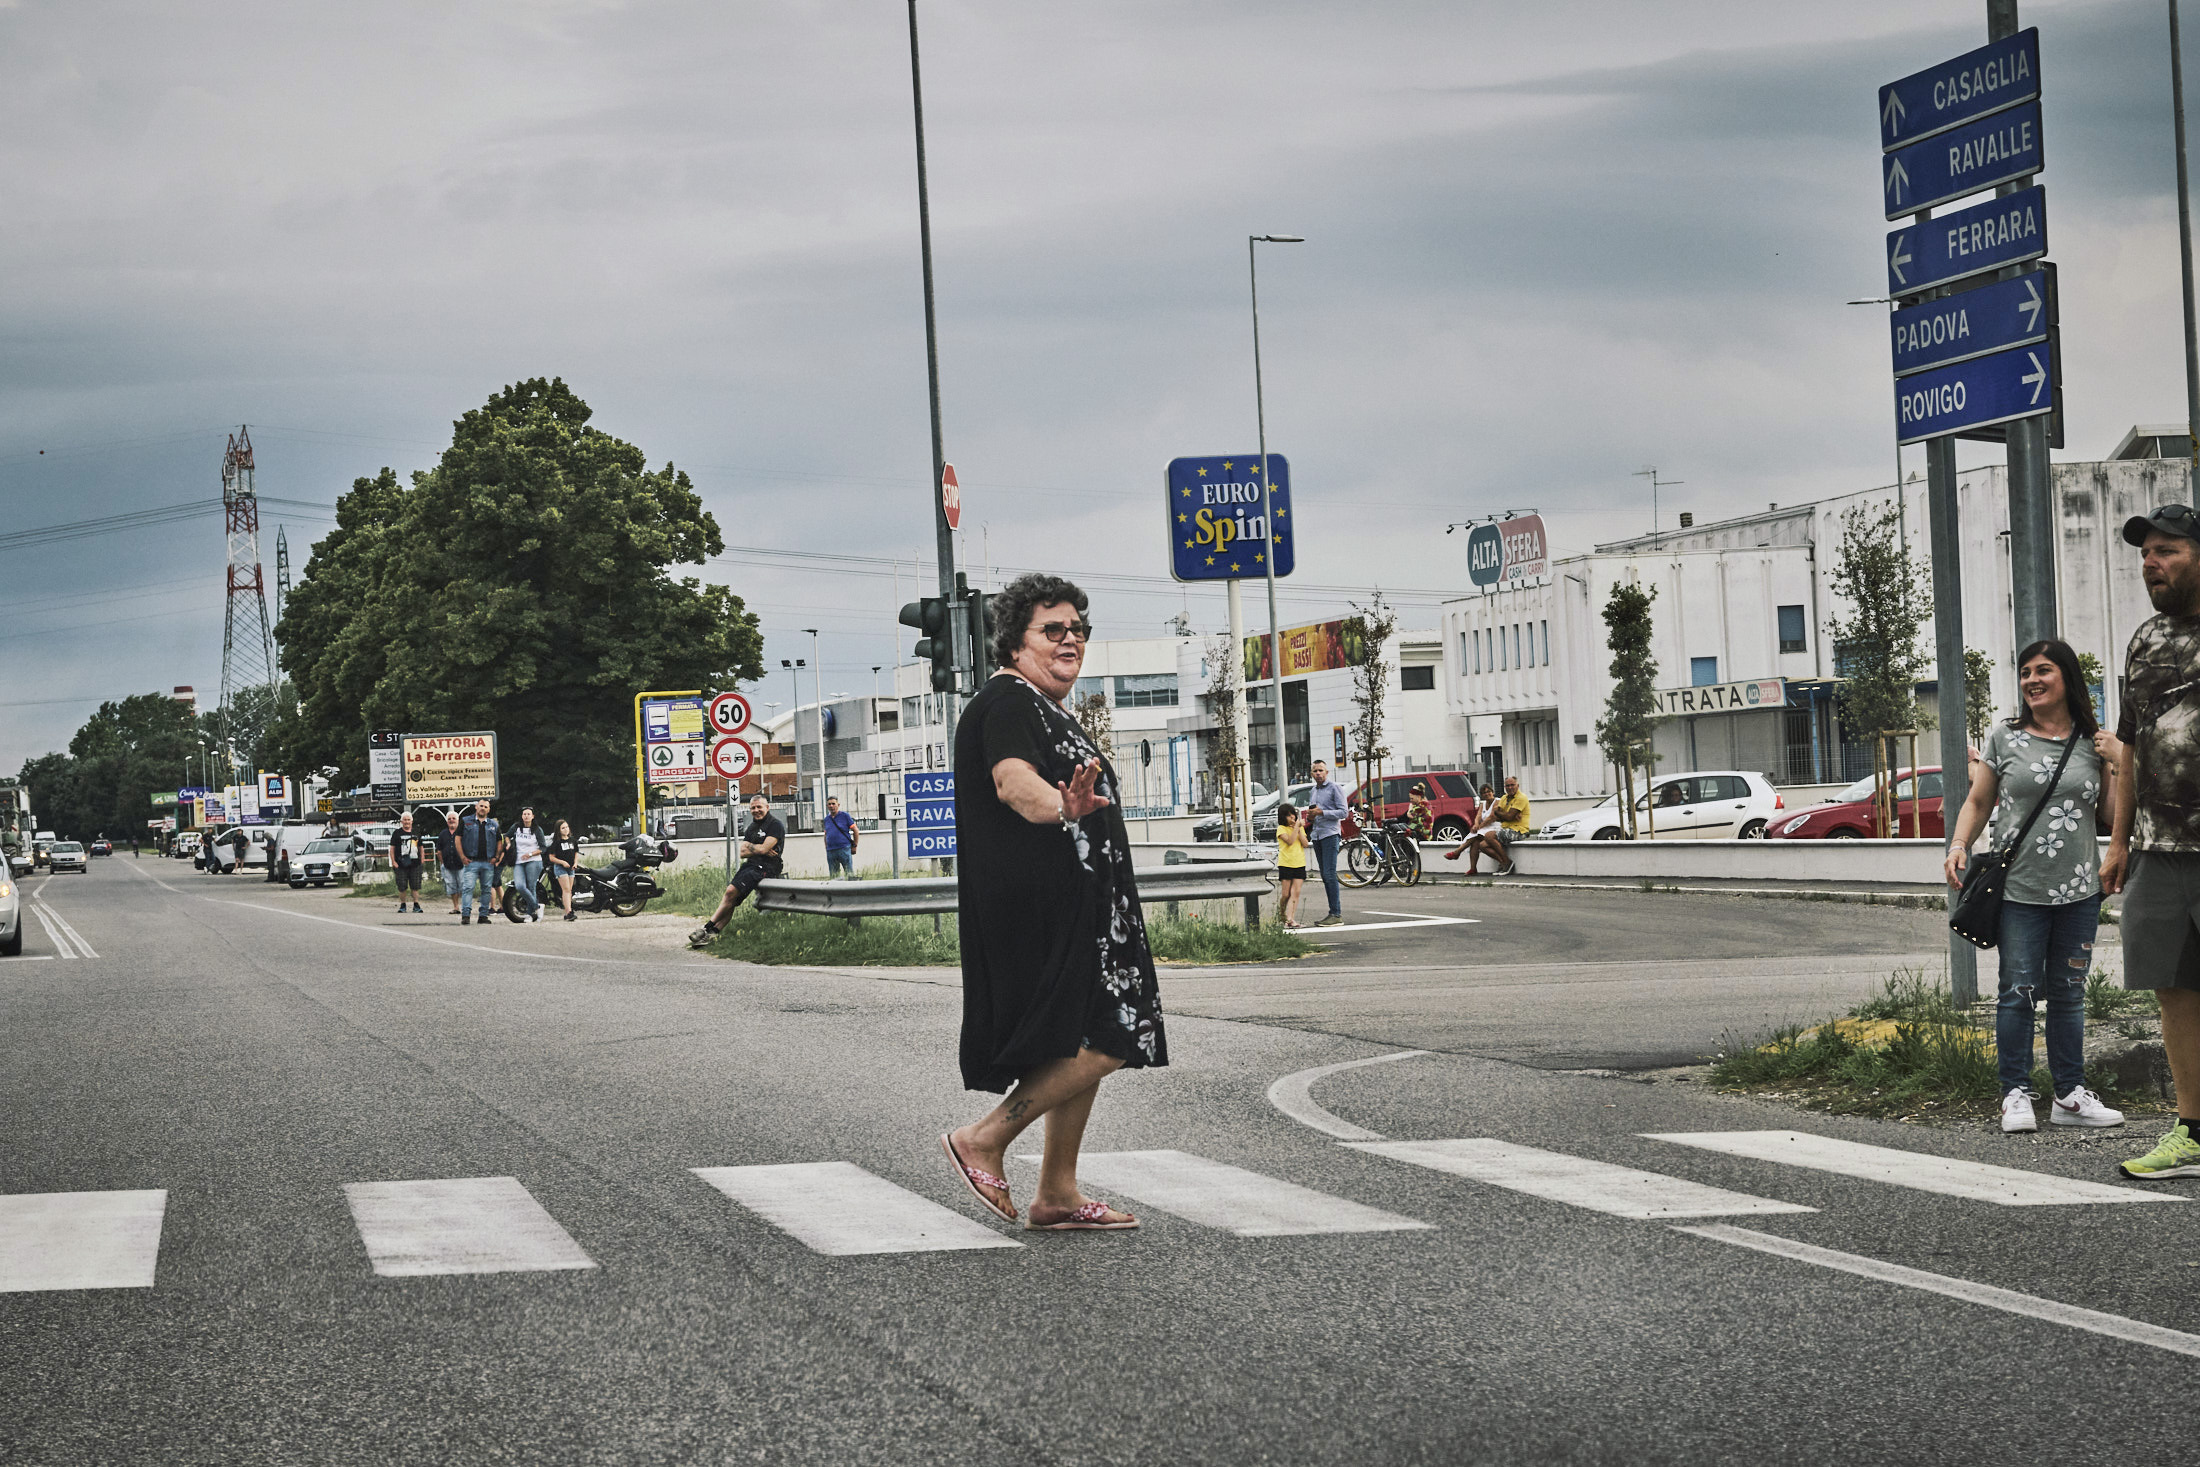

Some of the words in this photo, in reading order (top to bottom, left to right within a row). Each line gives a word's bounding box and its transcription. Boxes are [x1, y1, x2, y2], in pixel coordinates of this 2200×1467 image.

[1933, 49, 2030, 110] CASAGLIA
[1949, 121, 2033, 177] RAVALLE
[1948, 205, 2037, 259] FERRARA
[1897, 309, 1970, 354] PADOVA
[1902, 381, 1966, 424] ROVIGO
[943, 483, 959, 510] STOP
[1202, 482, 1260, 505] EURO
[1195, 508, 1266, 552] Spin
[1472, 540, 1499, 571] ALTA
[1505, 530, 1541, 566] SFERA
[1509, 566, 1522, 579] CASH
[1528, 561, 1544, 575] CARRY
[1290, 631, 1307, 649] PREZZI
[1294, 647, 1312, 669] BASSI
[1748, 688, 1759, 700] ALTA
[1761, 687, 1779, 699] SFERA
[671, 703, 698, 711] FERMATA
[719, 704, 743, 724] 50
[411, 737, 486, 749] TRATTORIA
[407, 752, 422, 762] La
[426, 751, 491, 761] Ferrarese
[651, 768, 704, 776] EUROSPAR
[909, 779, 955, 793] CASA
[911, 807, 956, 822] RAVA
[912, 836, 957, 850] PORP
